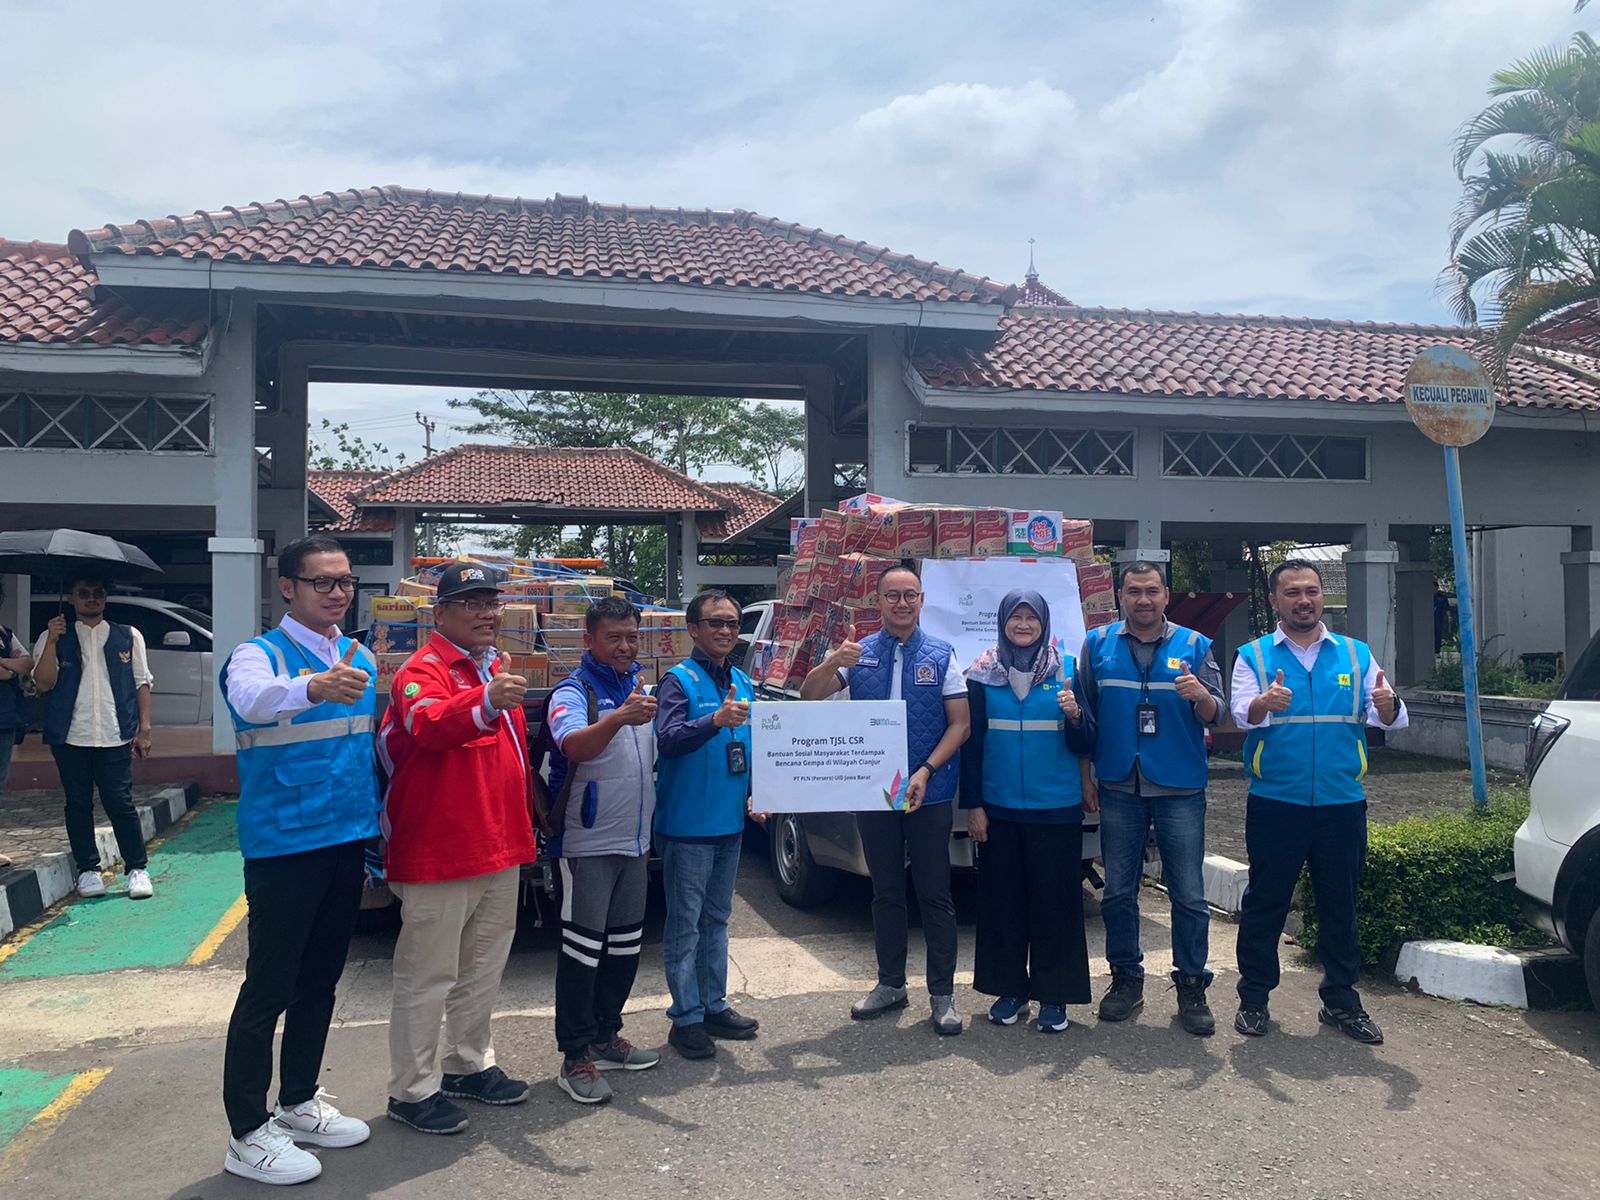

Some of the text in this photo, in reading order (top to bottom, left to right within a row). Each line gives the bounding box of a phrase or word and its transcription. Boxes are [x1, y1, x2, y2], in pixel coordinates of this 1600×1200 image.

[1412, 386, 1488, 403] KECUALI PEGAWAI
[1032, 521, 1047, 531] POP
[792, 736, 865, 747] Program TJSL CSR
[814, 750, 850, 758] Masyarakat
[851, 749, 885, 757] Terdampak
[833, 759, 857, 767] Wilayah
